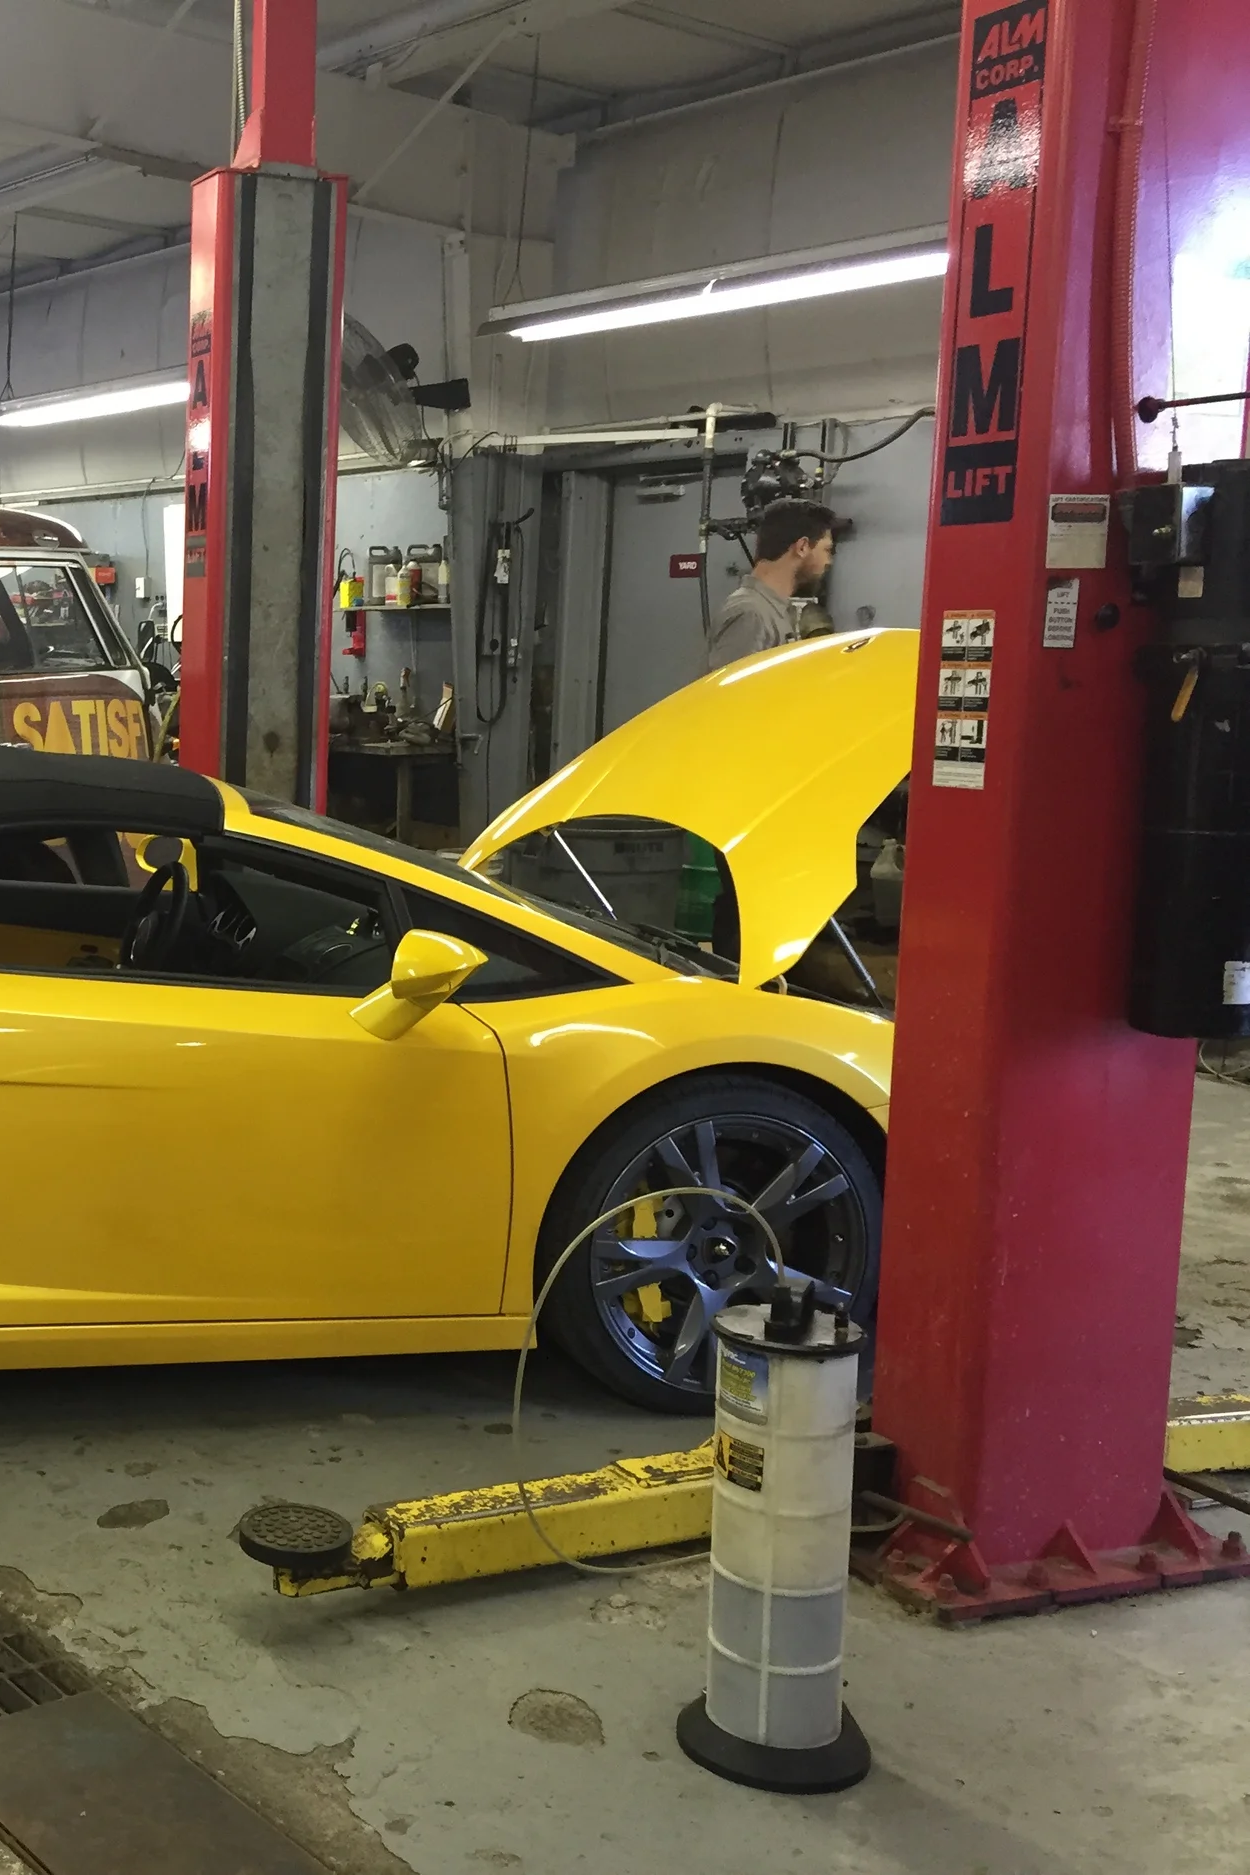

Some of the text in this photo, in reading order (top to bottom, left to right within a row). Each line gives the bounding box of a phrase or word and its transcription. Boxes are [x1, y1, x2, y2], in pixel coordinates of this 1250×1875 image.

[976, 8, 1047, 65] ALM
[975, 54, 1040, 91] CORP.
[946, 465, 1013, 499] LIFT
[678, 561, 697, 570] YARD
